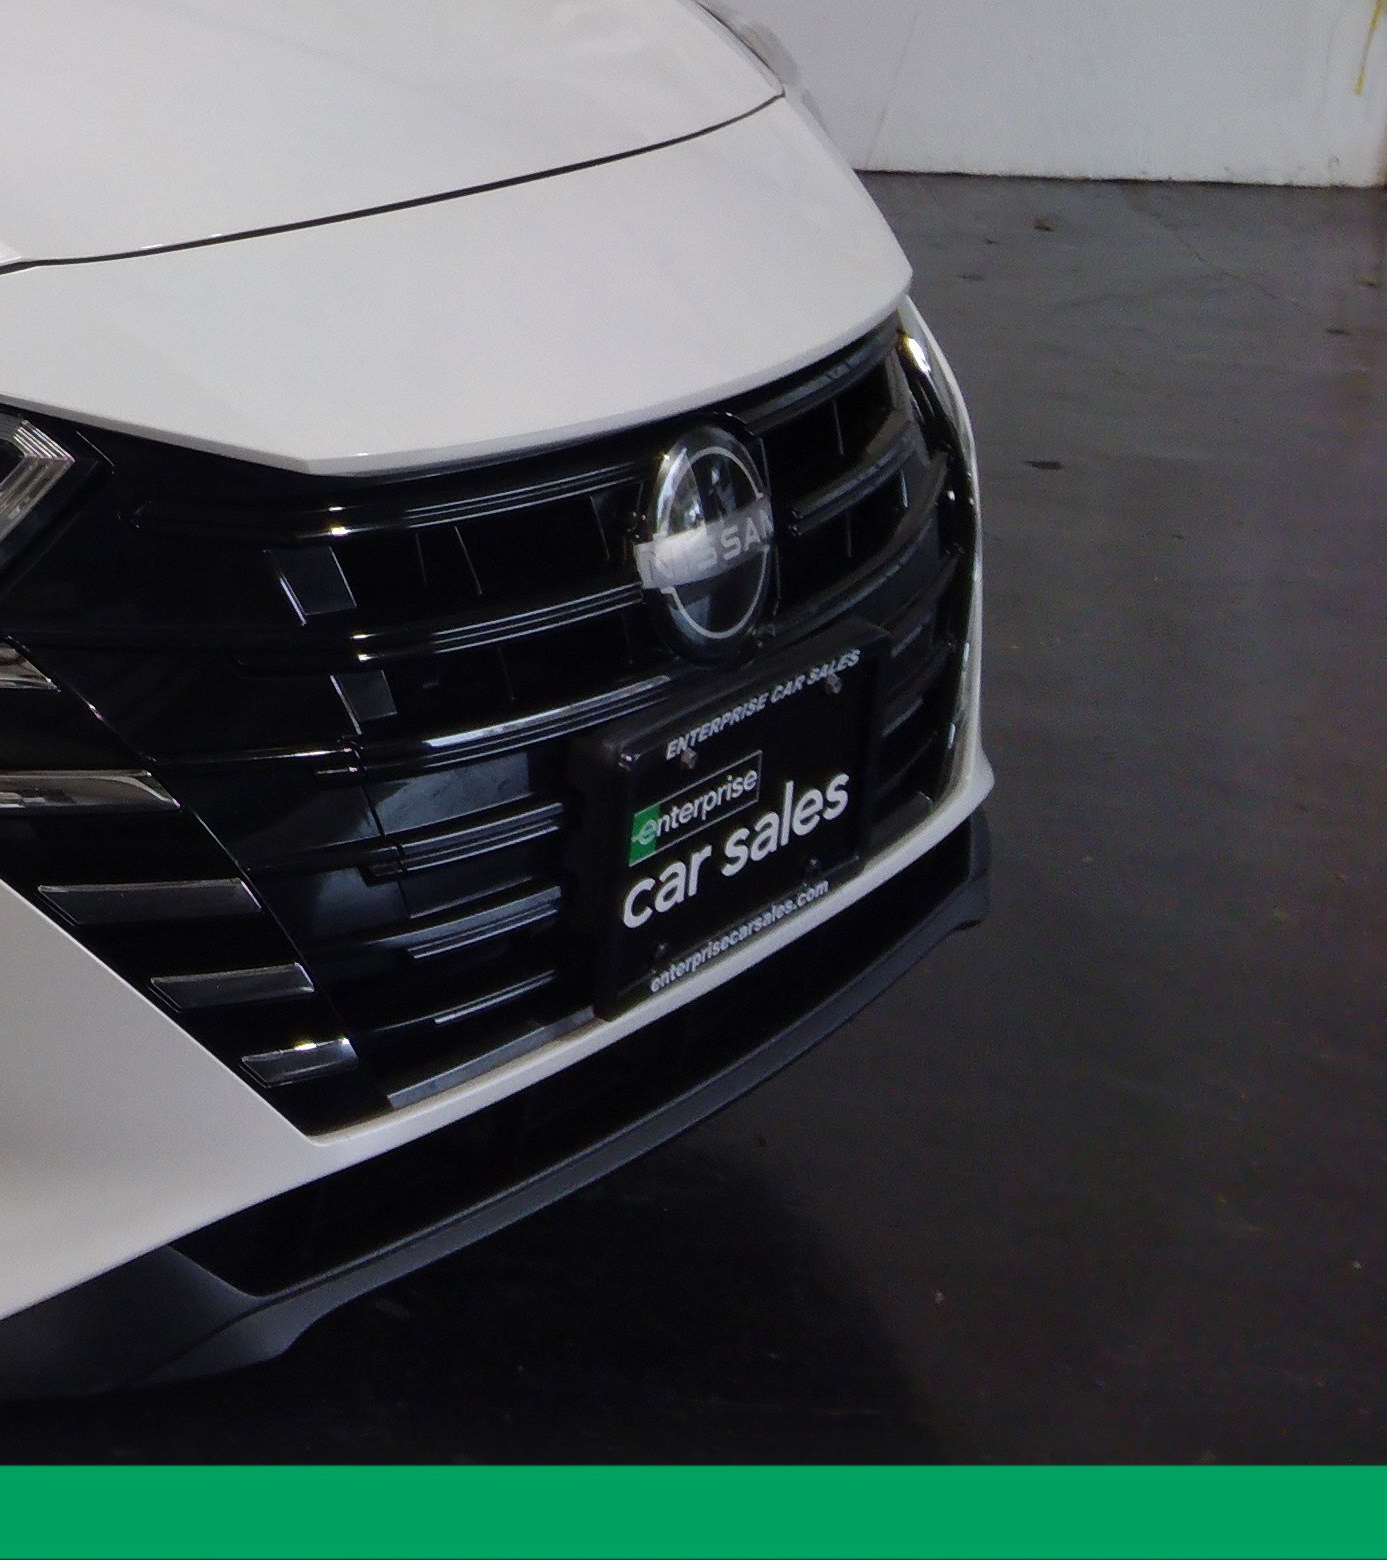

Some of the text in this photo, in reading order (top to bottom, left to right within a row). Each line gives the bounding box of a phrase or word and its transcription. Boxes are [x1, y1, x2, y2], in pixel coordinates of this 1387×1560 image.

[637, 509, 775, 585] NSSAN
[666, 648, 861, 760] ENTERPRISE CAR SALES
[623, 772, 850, 929] car sales
[634, 770, 758, 844] enterprise
[650, 880, 829, 993] enterprisecarsales.com
